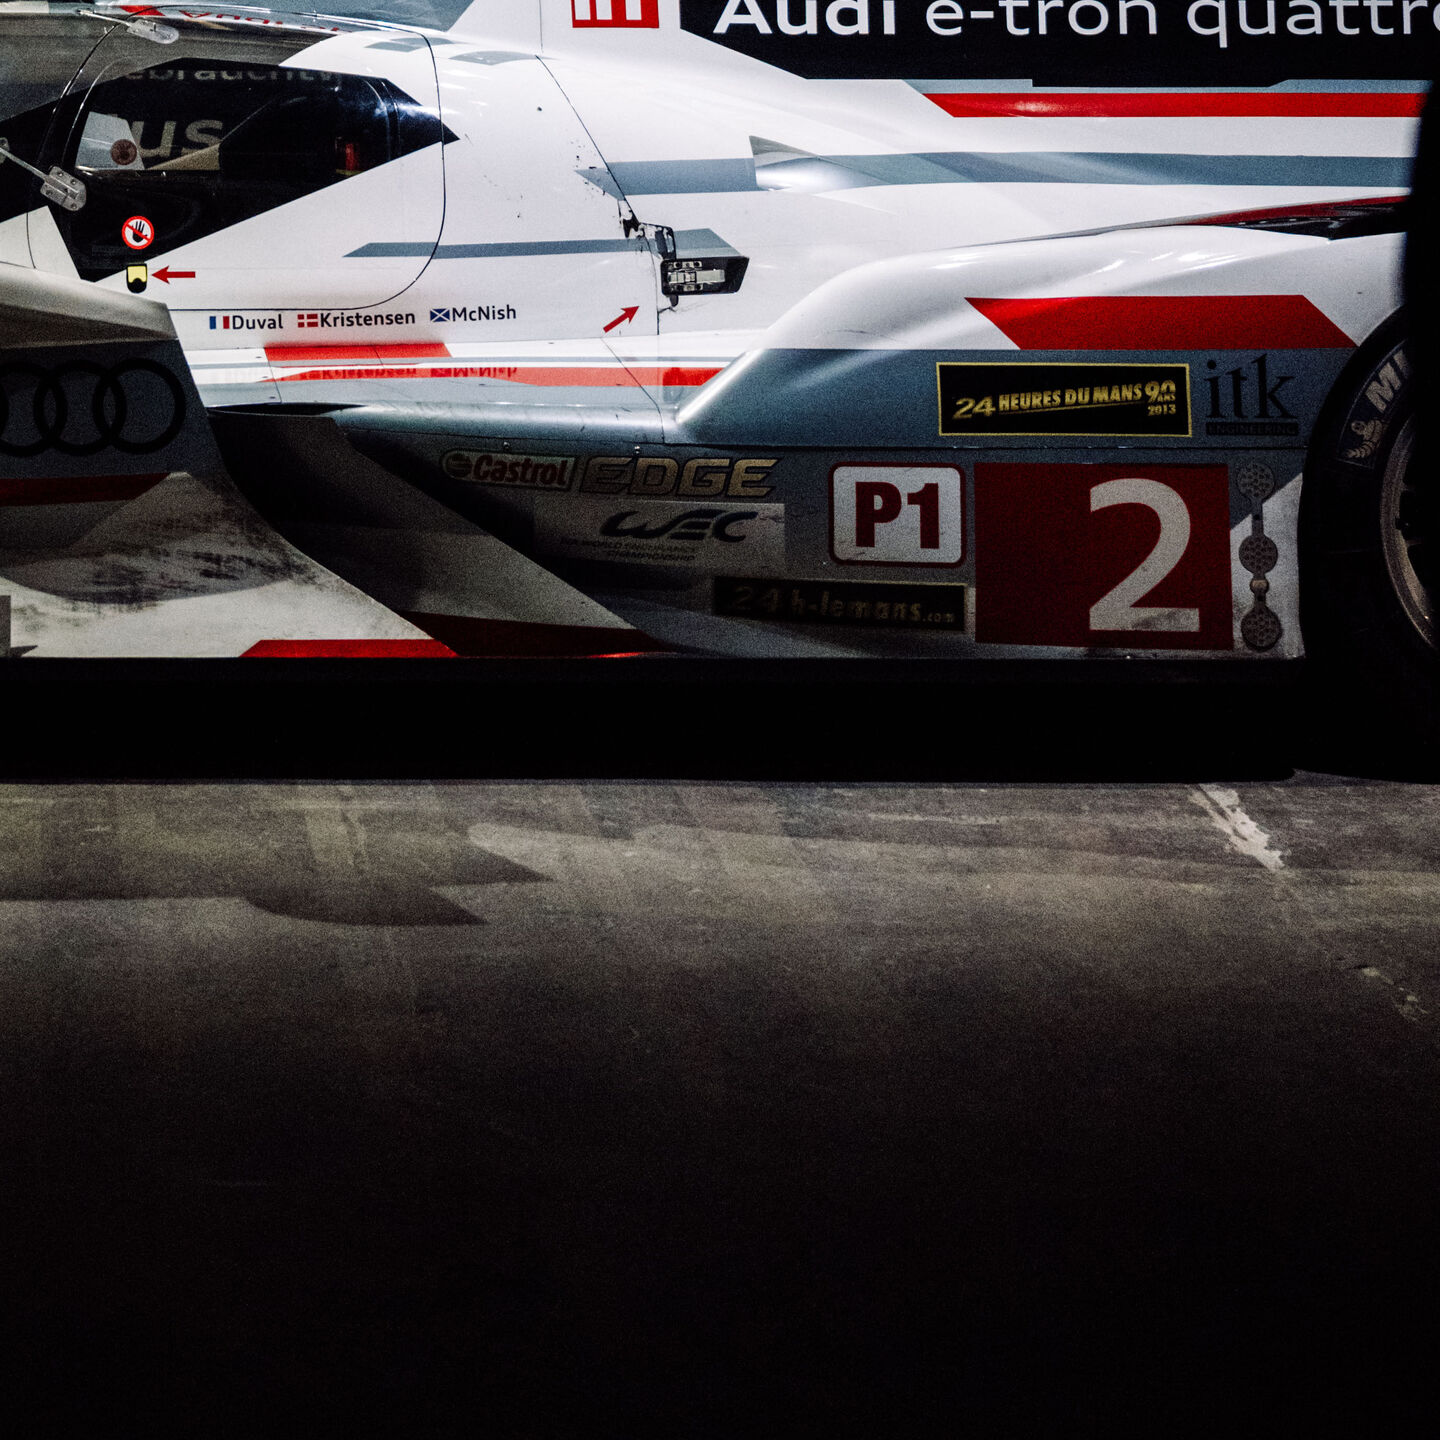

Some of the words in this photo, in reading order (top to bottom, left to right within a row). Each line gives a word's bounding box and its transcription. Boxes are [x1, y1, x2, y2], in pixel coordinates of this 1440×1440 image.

[232, 315, 283, 330] Duval
[319, 309, 416, 328] Kristensen
[452, 304, 516, 323] McNish
[952, 396, 996, 420] 24
[999, 389, 1061, 412] HEURES
[1064, 387, 1090, 405] DU
[1092, 382, 1143, 403] MANS
[1203, 353, 1298, 419] itk
[1147, 403, 1176, 417] 2013
[1208, 424, 1297, 436] ENGINEERING
[473, 454, 566, 487] Castrol
[580, 457, 783, 497] EDGE
[601, 509, 759, 542] WEC
[855, 481, 940, 550] P1
[1088, 478, 1202, 633] 2
